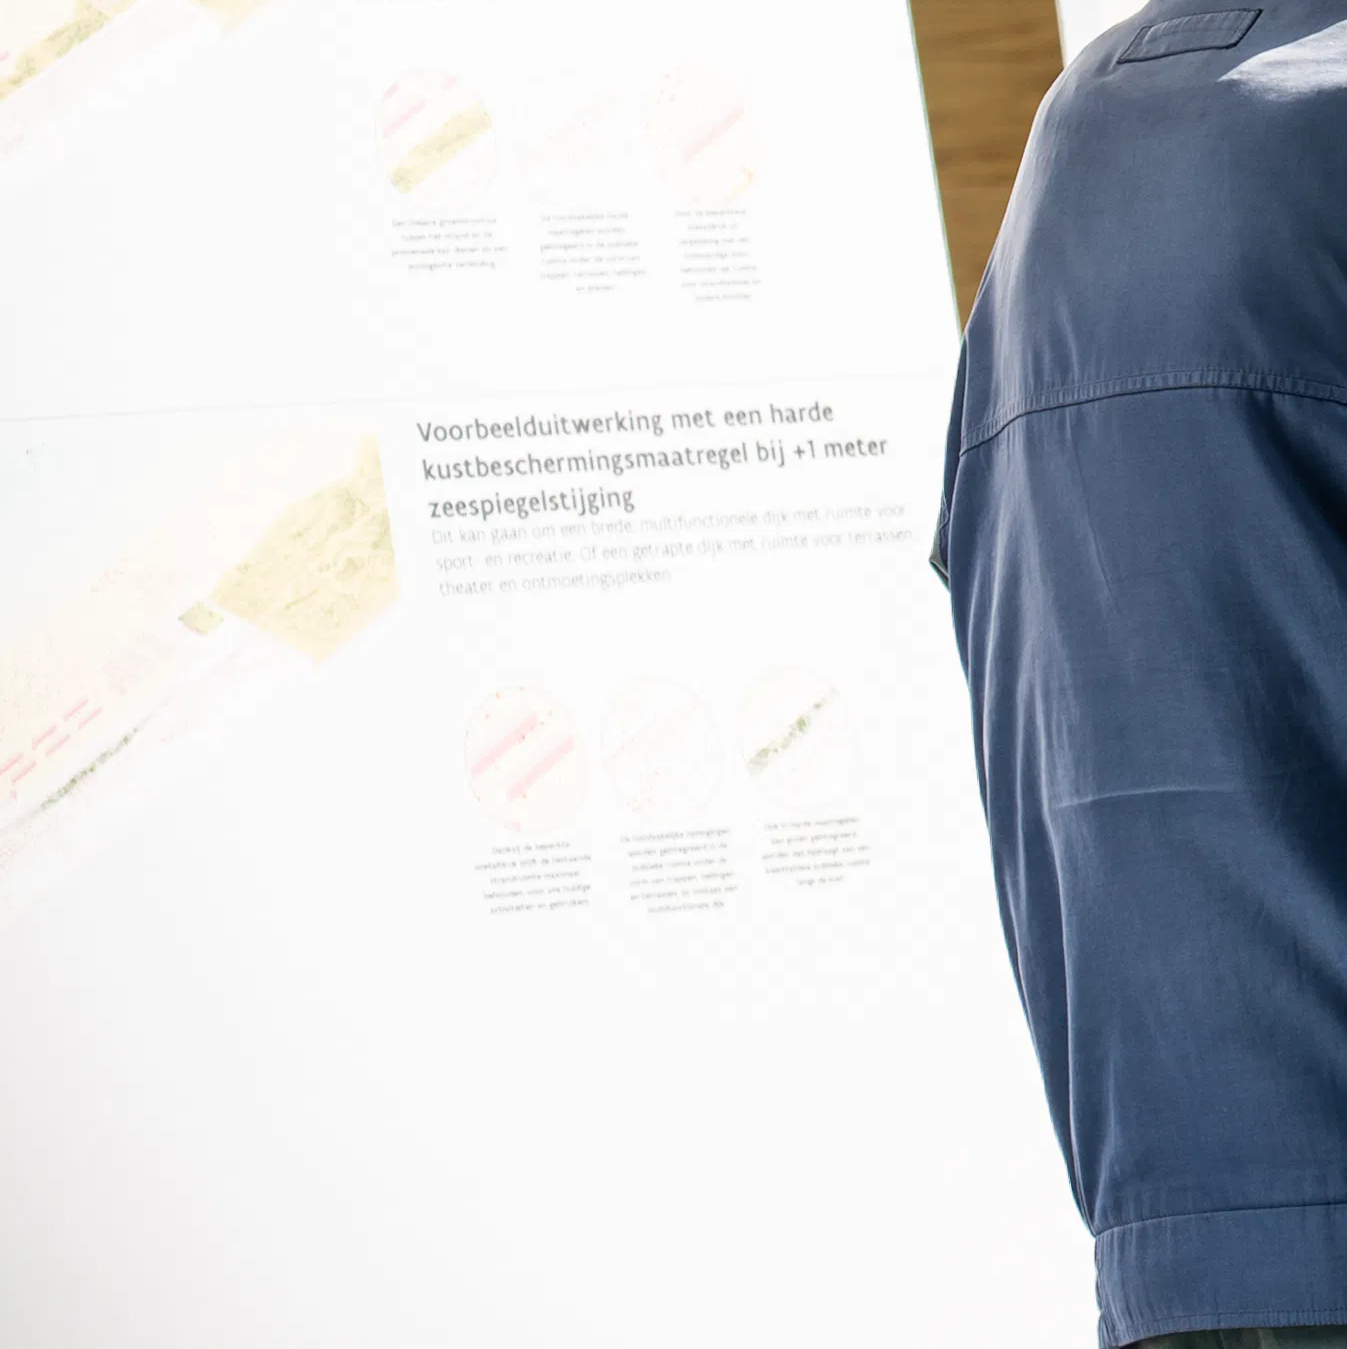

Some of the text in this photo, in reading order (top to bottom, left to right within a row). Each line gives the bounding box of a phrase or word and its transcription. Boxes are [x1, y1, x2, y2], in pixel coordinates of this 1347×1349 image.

[416, 401, 835, 443] Voorbeelduitwerking met een harde
[422, 437, 889, 481] kustbeschermingsmaatregel bij +1 meter
[428, 488, 636, 521] zeespiegelstijging
